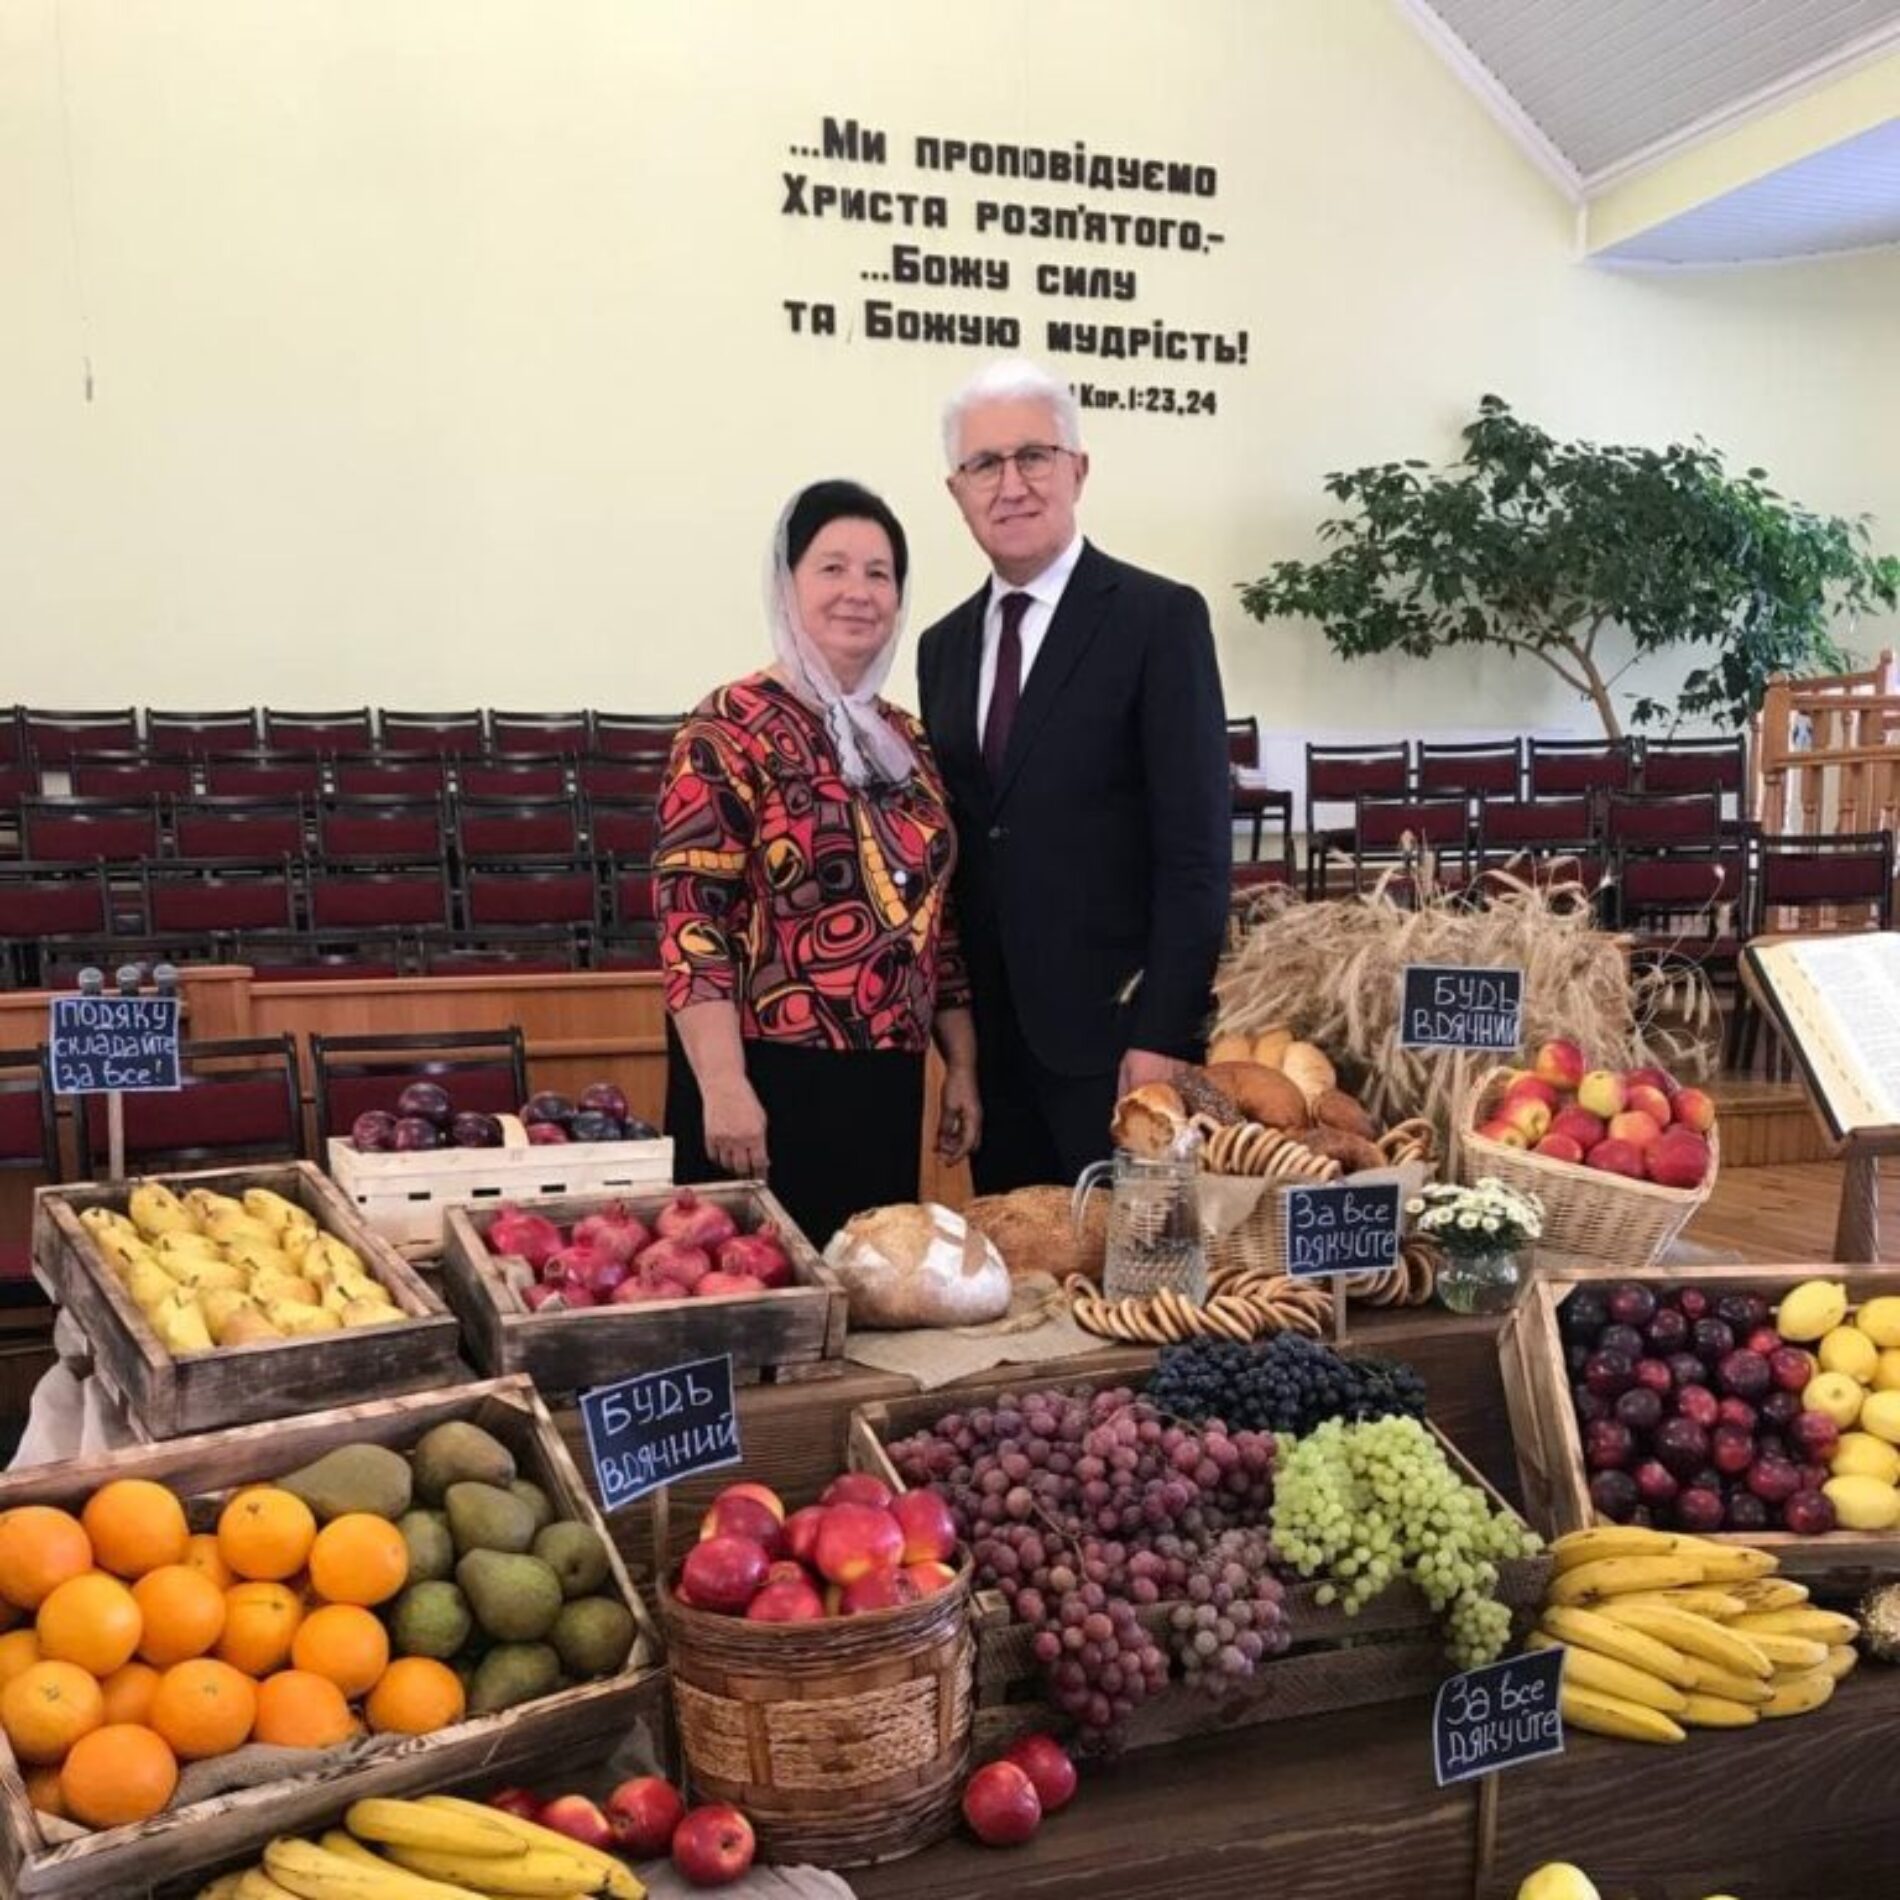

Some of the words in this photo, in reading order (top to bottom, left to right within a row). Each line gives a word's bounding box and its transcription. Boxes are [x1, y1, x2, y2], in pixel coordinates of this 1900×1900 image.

[790, 117, 887, 164] ...Ми
[915, 136, 1218, 198] проповідуємо
[781, 172, 948, 228] Христа
[860, 245, 1010, 290] ...Божу
[1037, 264, 1137, 301] силу
[784, 300, 836, 336] та
[864, 299, 1020, 348] Божую
[1046, 319, 1249, 365] мудрість!
[1296, 1193, 1335, 1229] За
[1343, 1191, 1390, 1224] все
[1446, 1675, 1490, 1725] За
[1500, 1670, 1545, 1710] все
